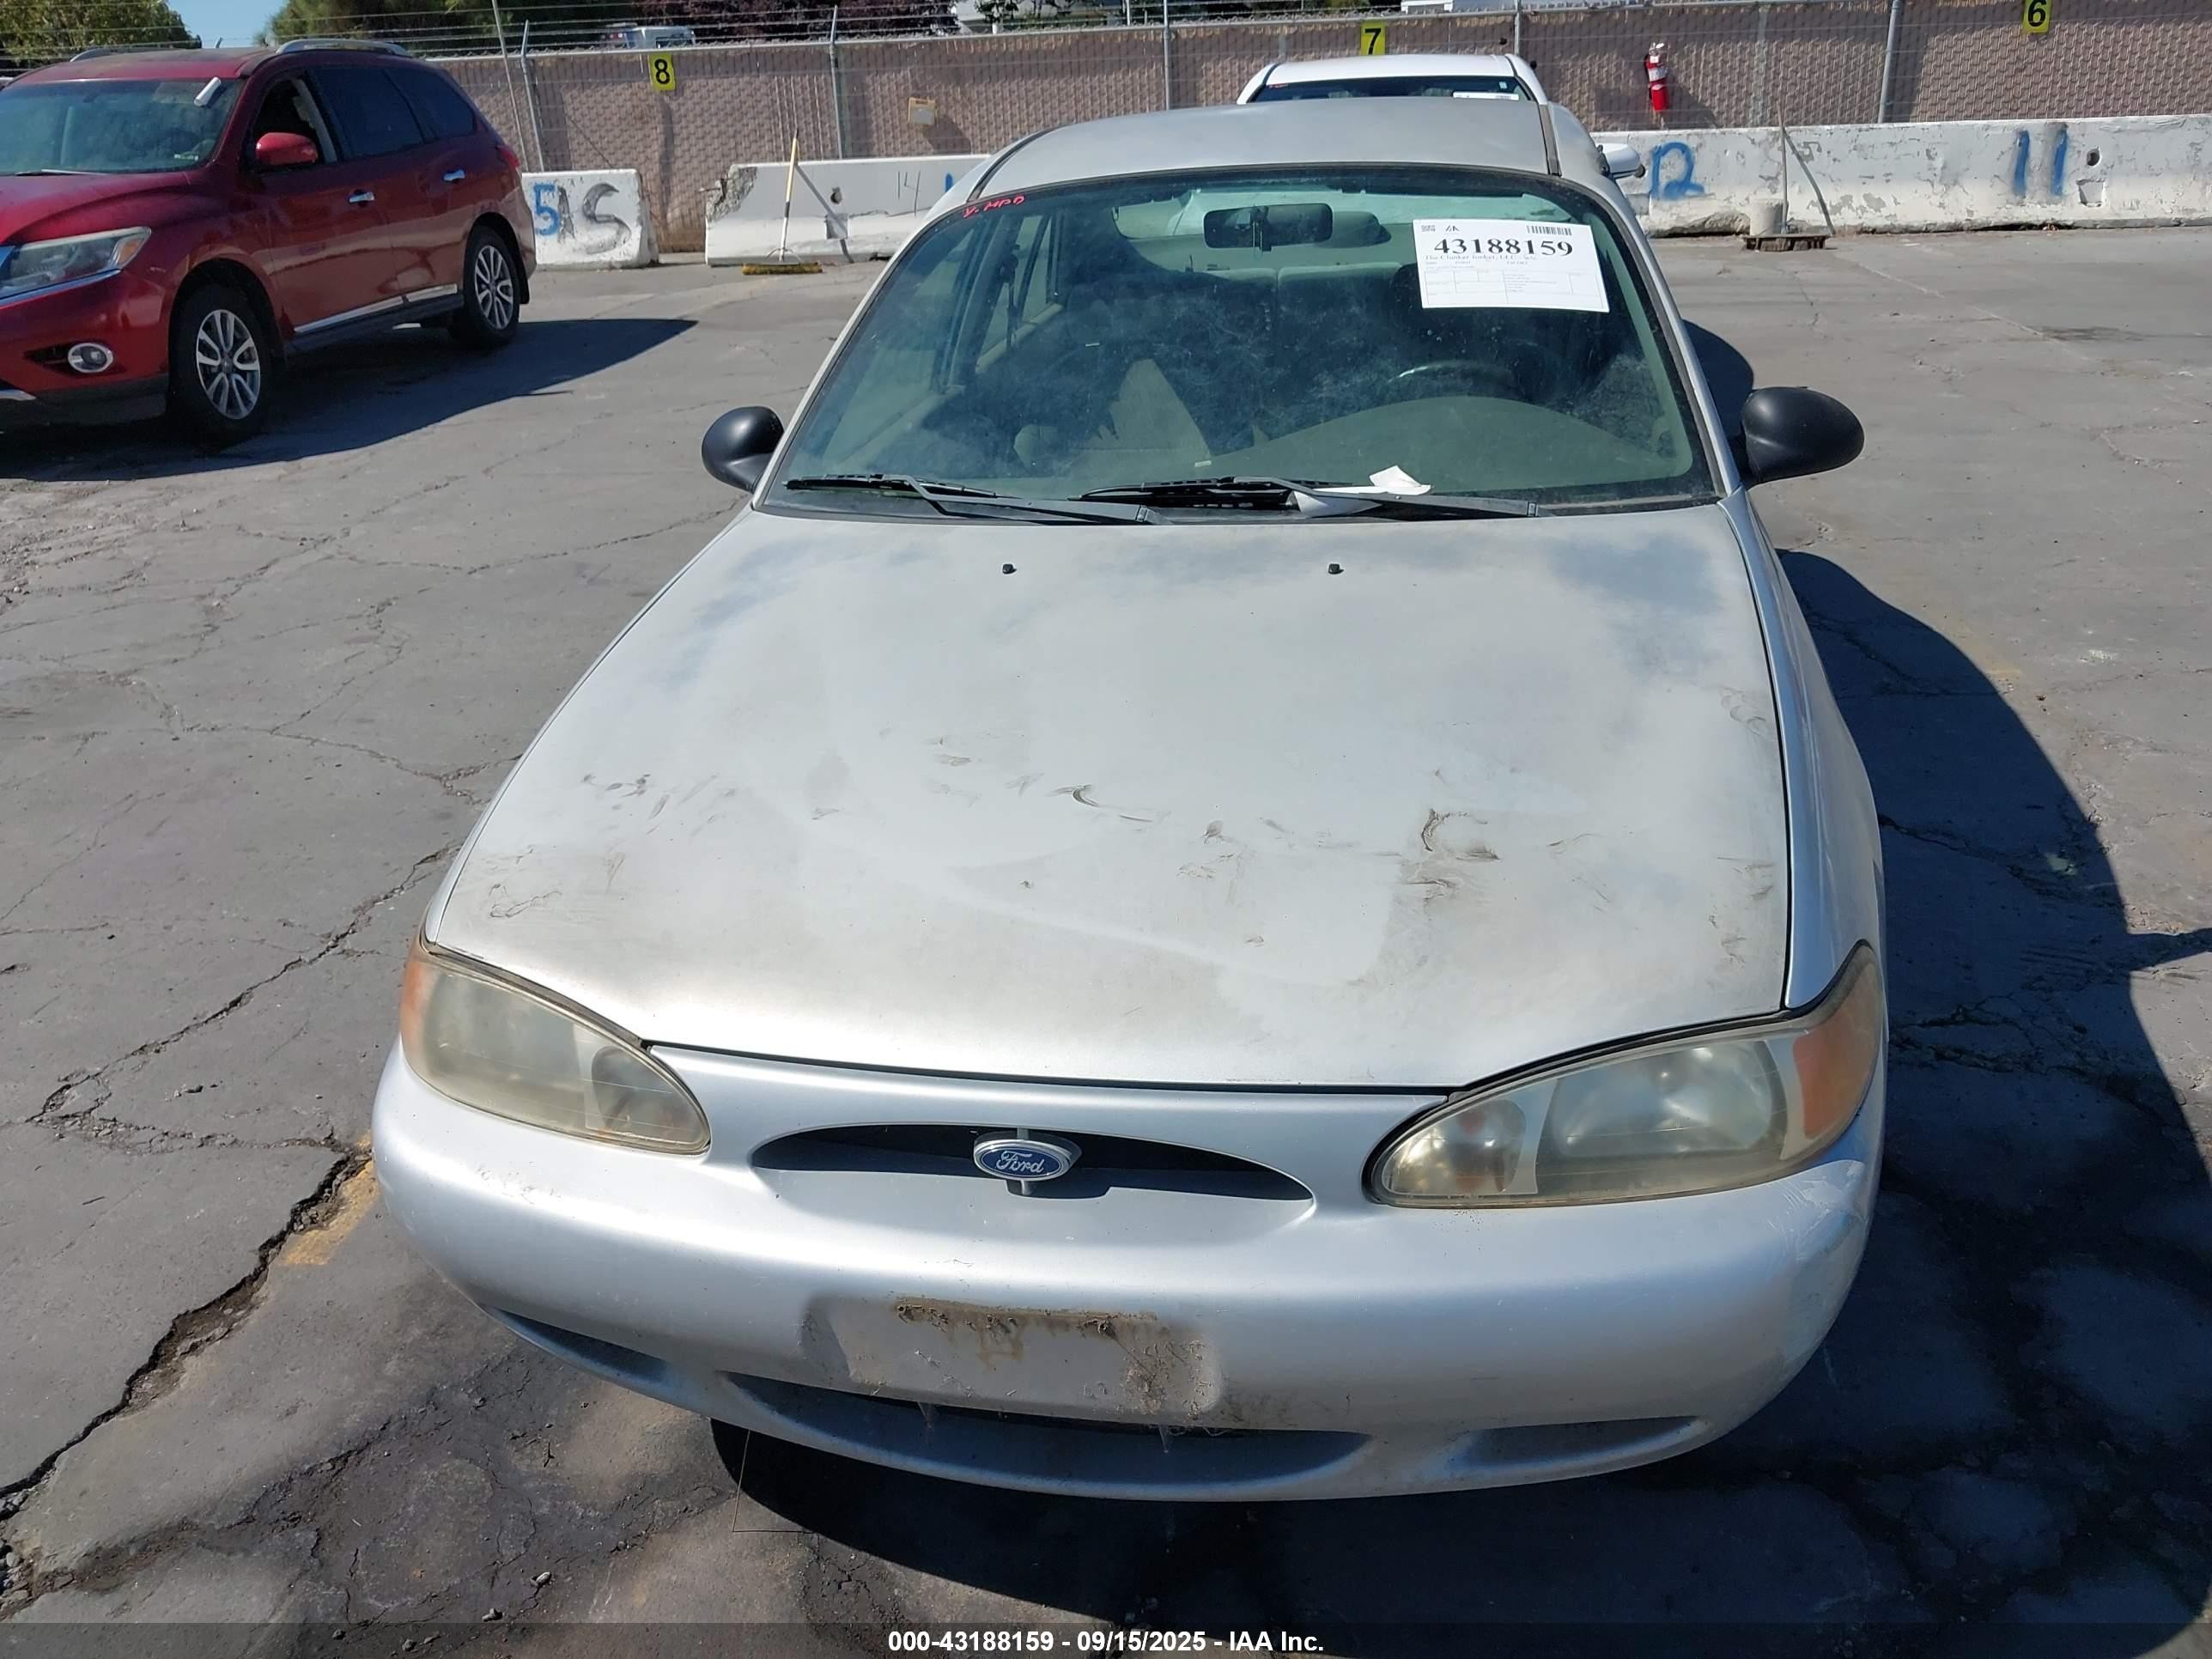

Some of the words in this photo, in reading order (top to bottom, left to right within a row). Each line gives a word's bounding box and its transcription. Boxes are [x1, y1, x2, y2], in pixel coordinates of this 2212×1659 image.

[2027, 0, 2046, 27] 6
[1364, 27, 1382, 55] 7
[654, 58, 670, 84] 8
[1434, 238, 1573, 257] 43188159
[996, 1151, 1045, 1173] Ford
